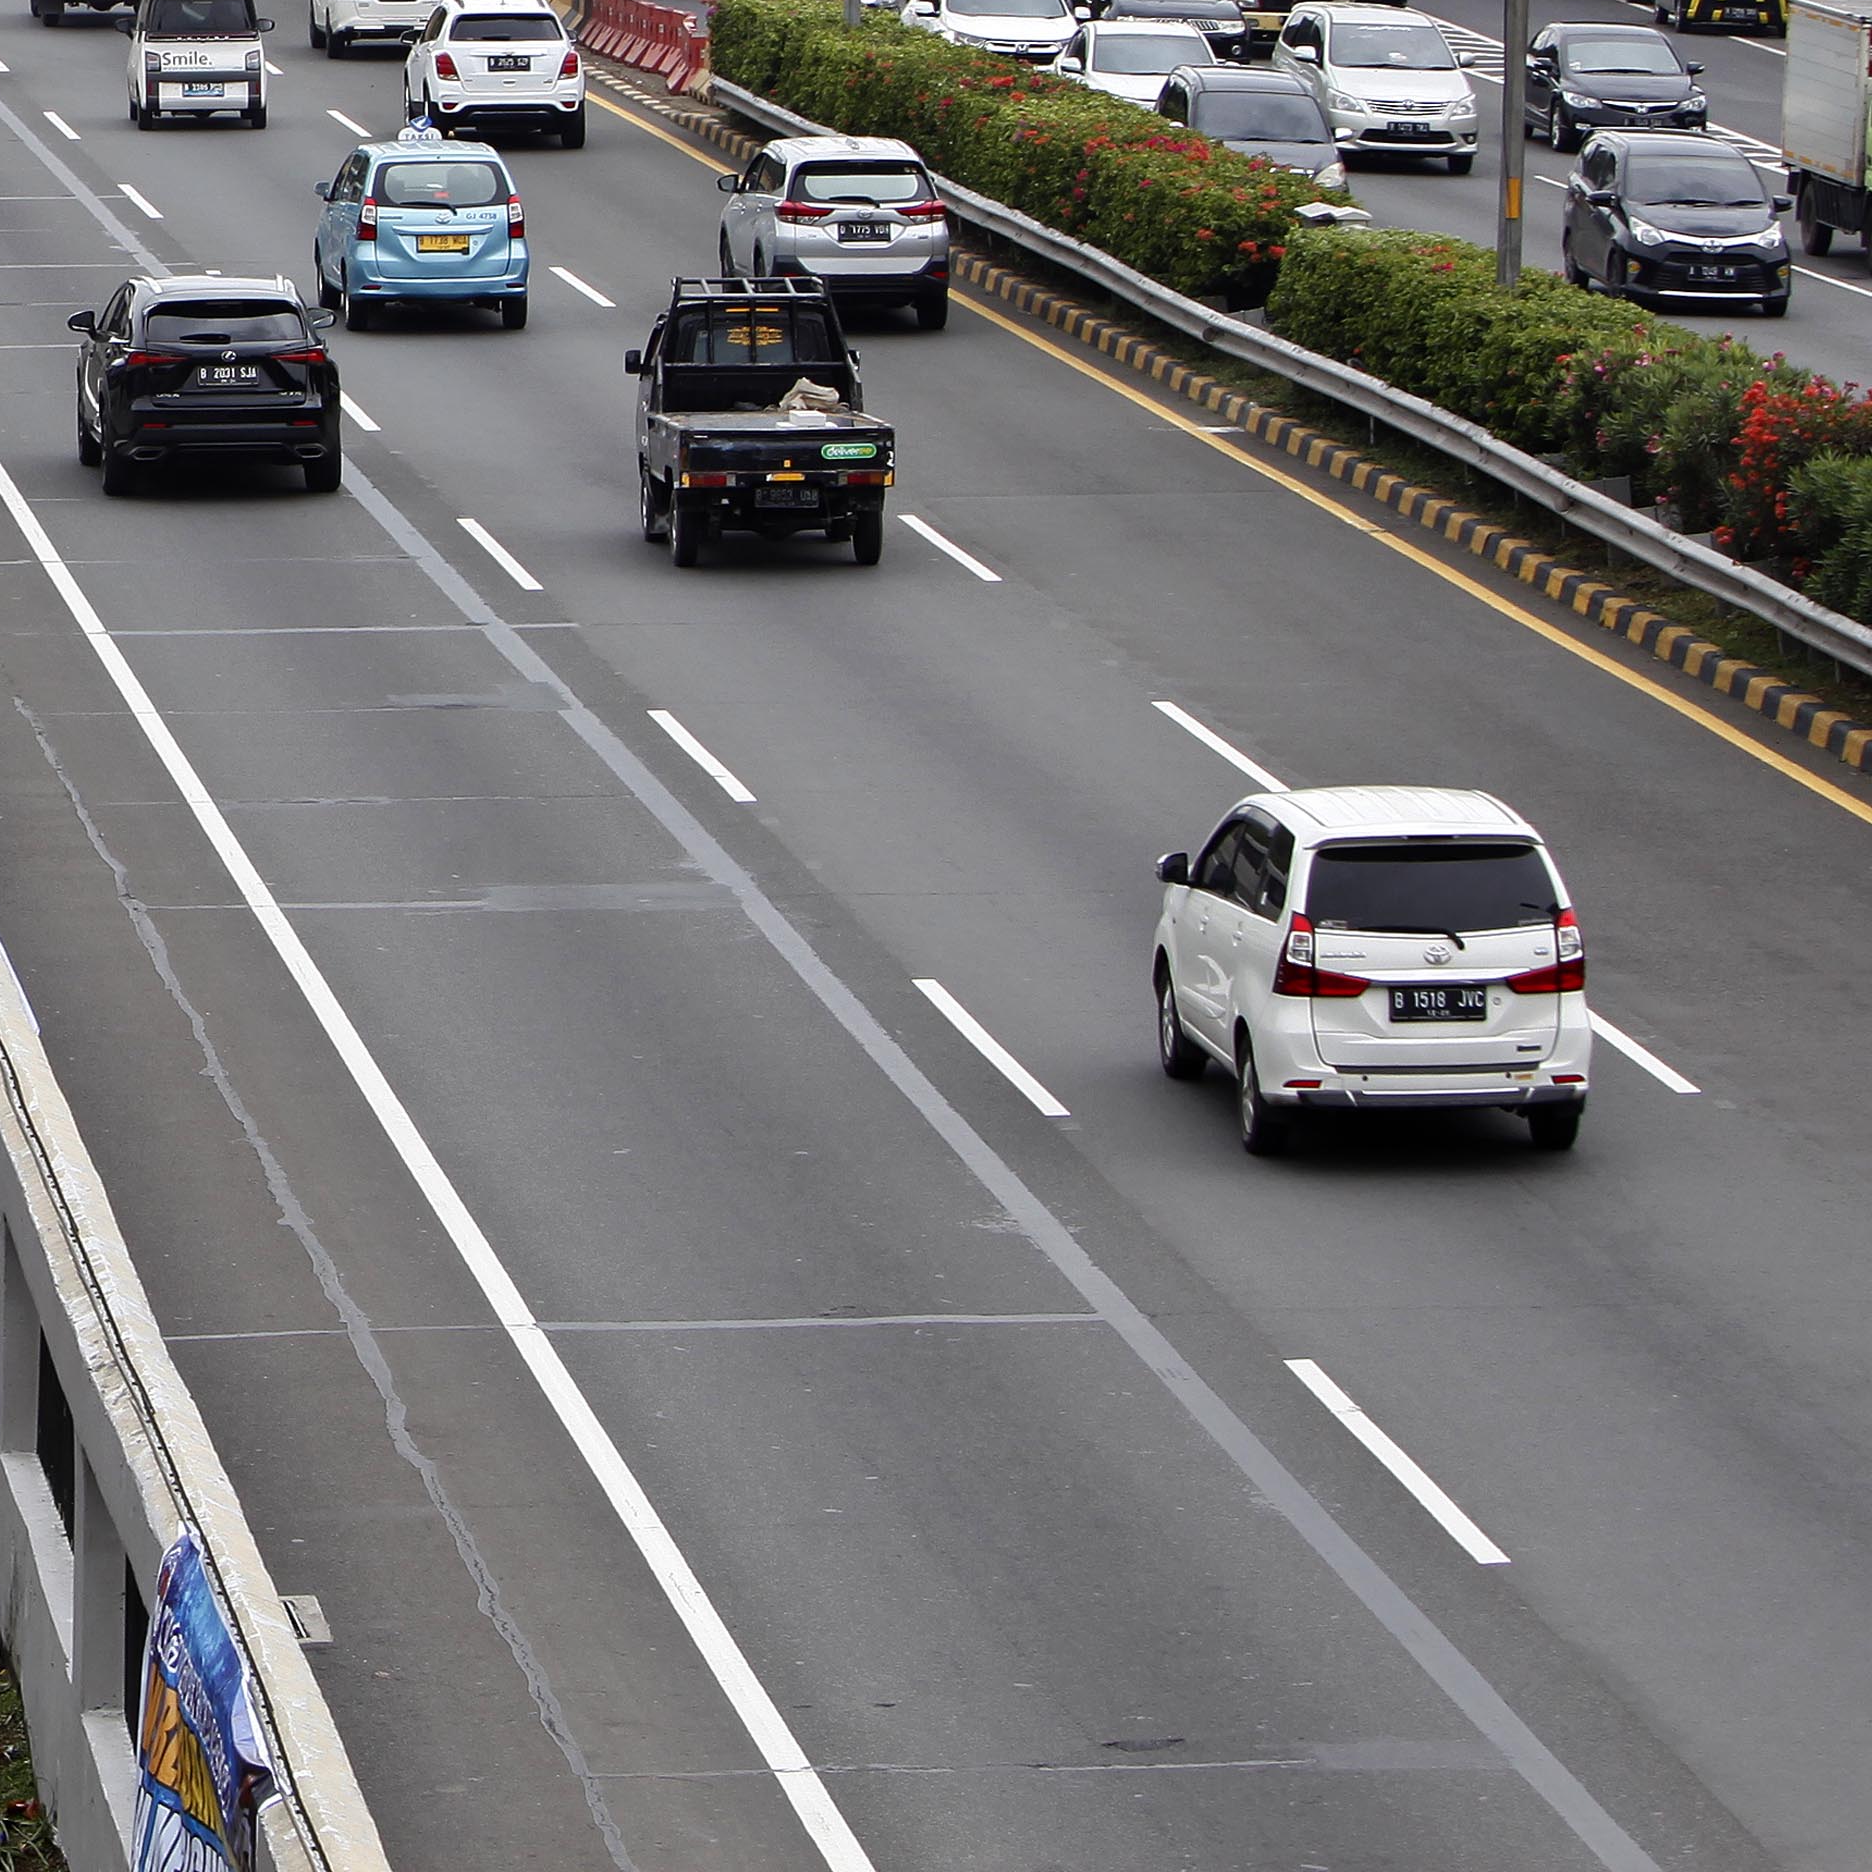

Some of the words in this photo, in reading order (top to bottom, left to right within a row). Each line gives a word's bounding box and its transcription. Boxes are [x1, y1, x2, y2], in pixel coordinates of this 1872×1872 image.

[162, 50, 213, 66] Smile.
[200, 367, 207, 380] B
[213, 367, 236, 379] 2031
[1395, 991, 1404, 1009] B
[1413, 991, 1445, 1007] 1518
[1457, 990, 1485, 1007] JVC
